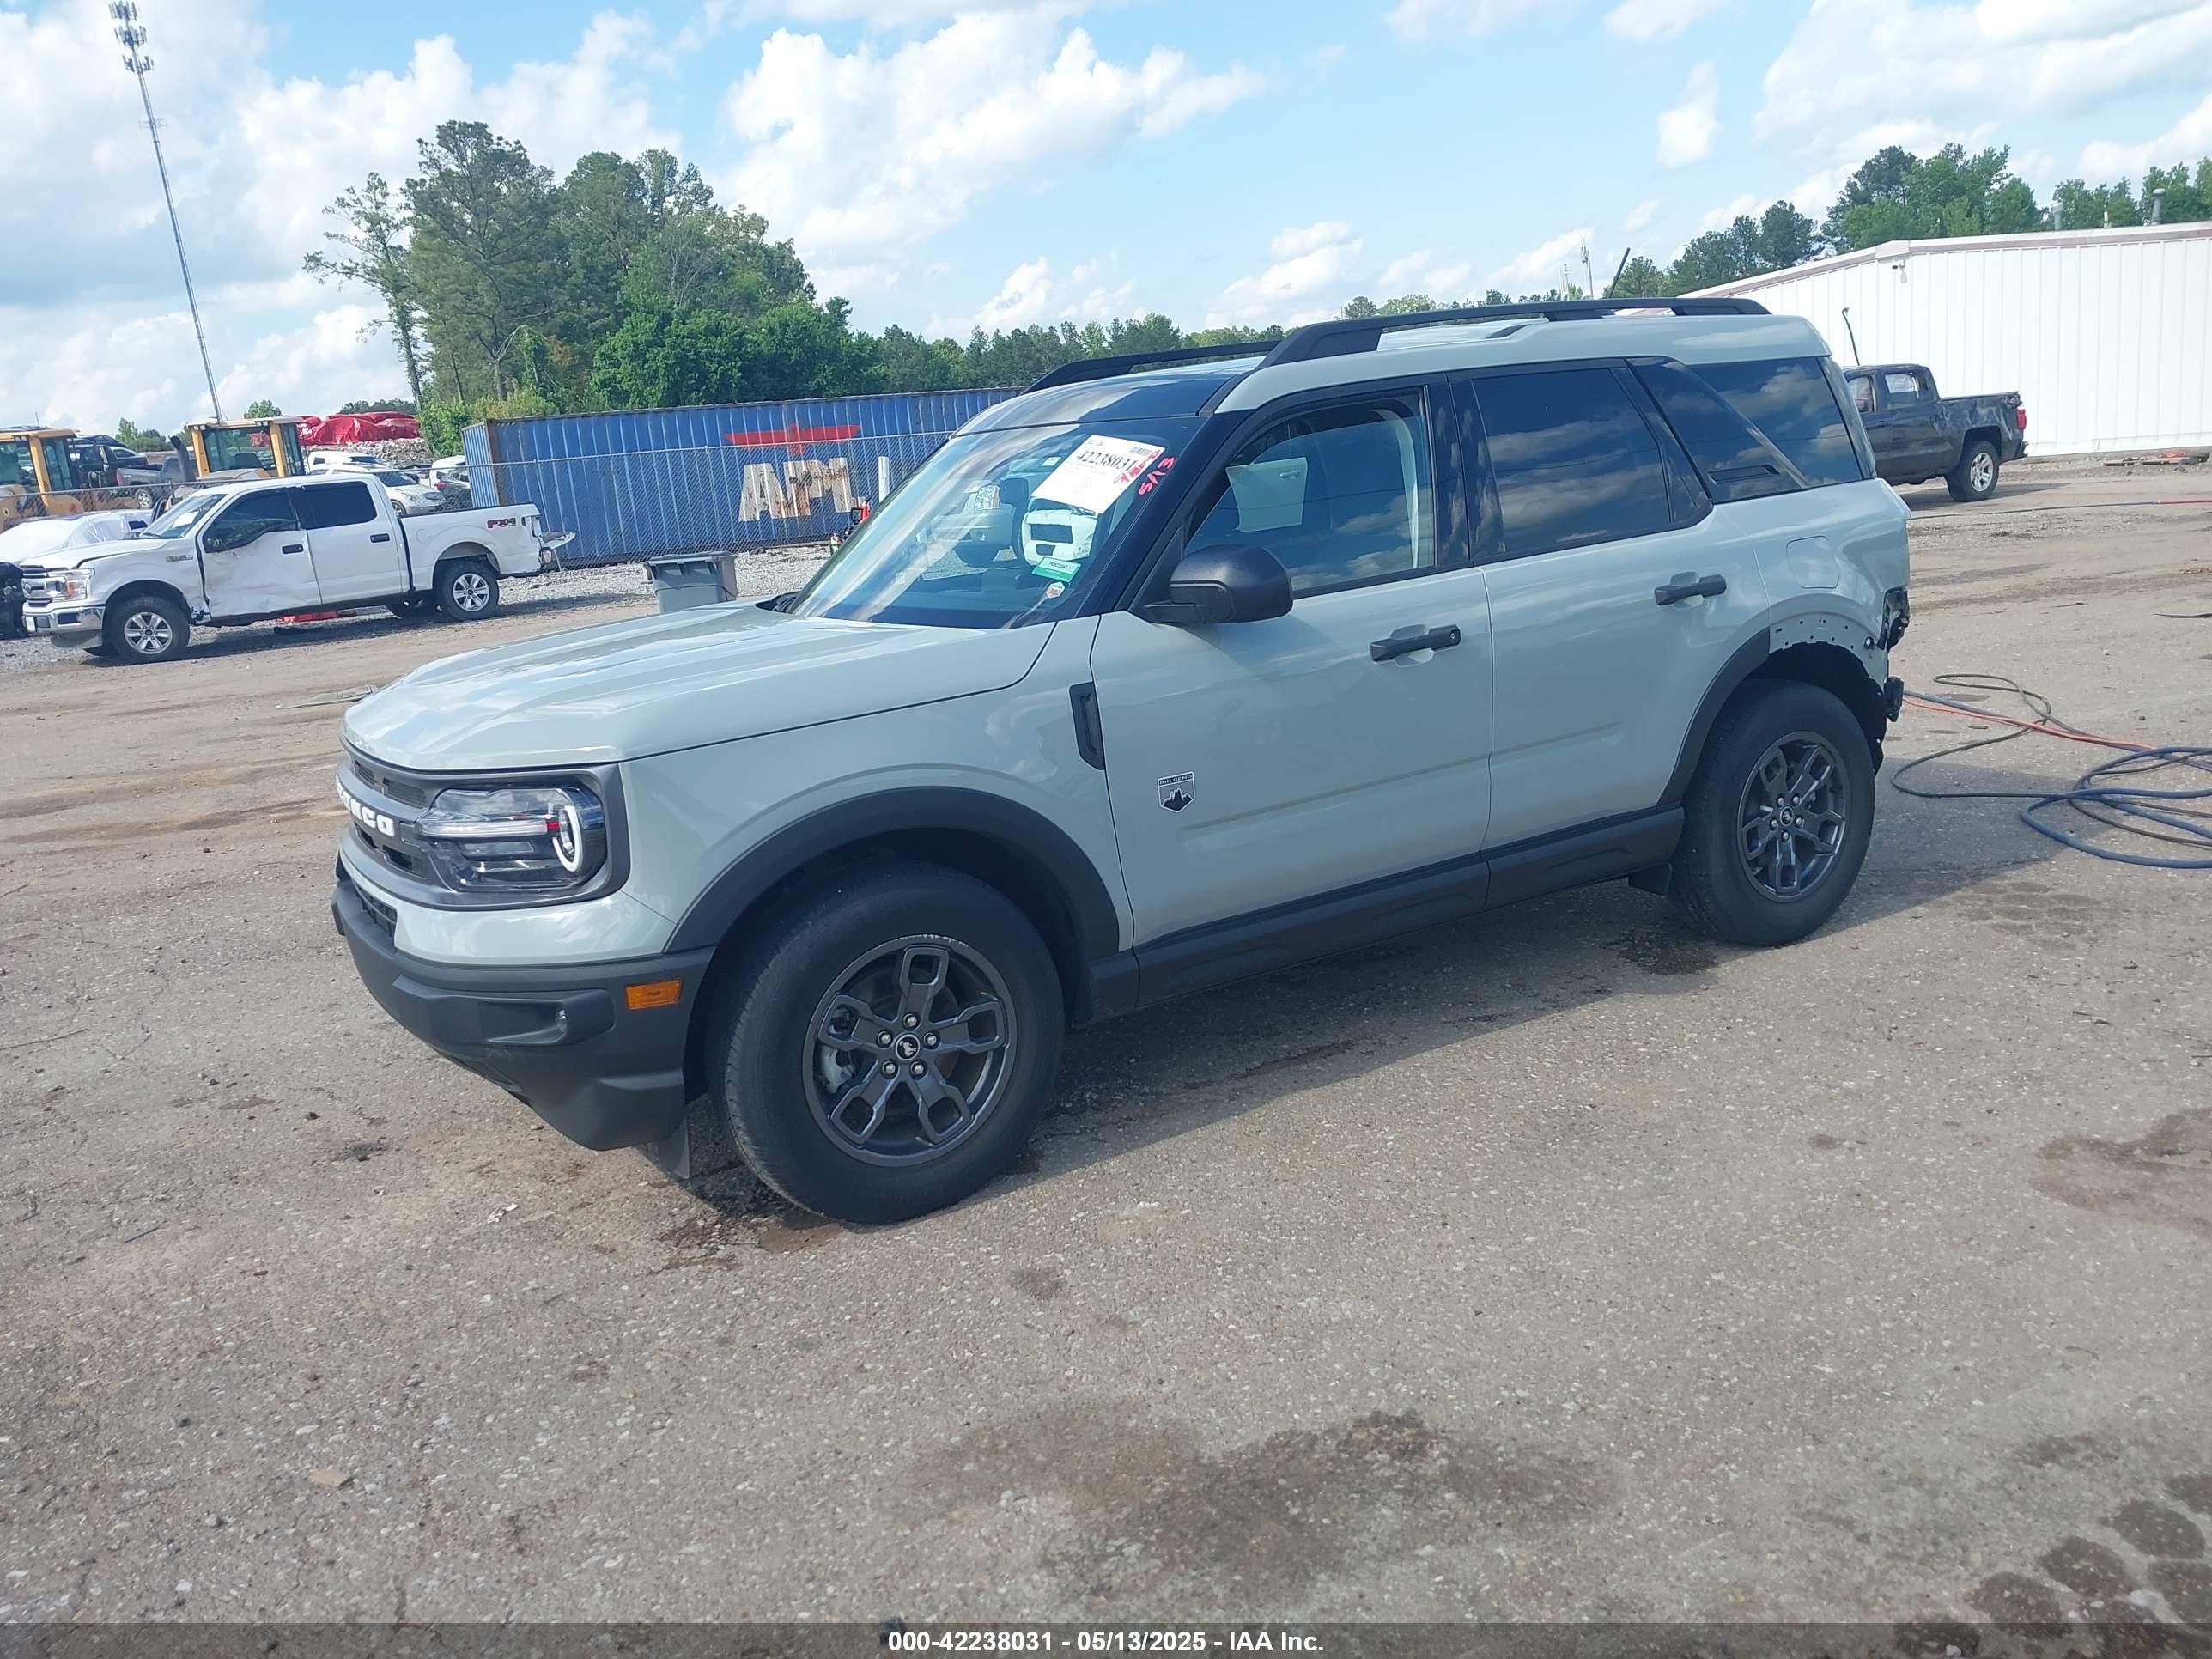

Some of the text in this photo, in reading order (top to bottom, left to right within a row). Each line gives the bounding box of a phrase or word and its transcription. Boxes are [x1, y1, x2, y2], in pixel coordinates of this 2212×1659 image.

[1077, 450, 1139, 471] 42238031
[487, 517, 516, 528] FX4
[336, 775, 395, 837] ONCO
